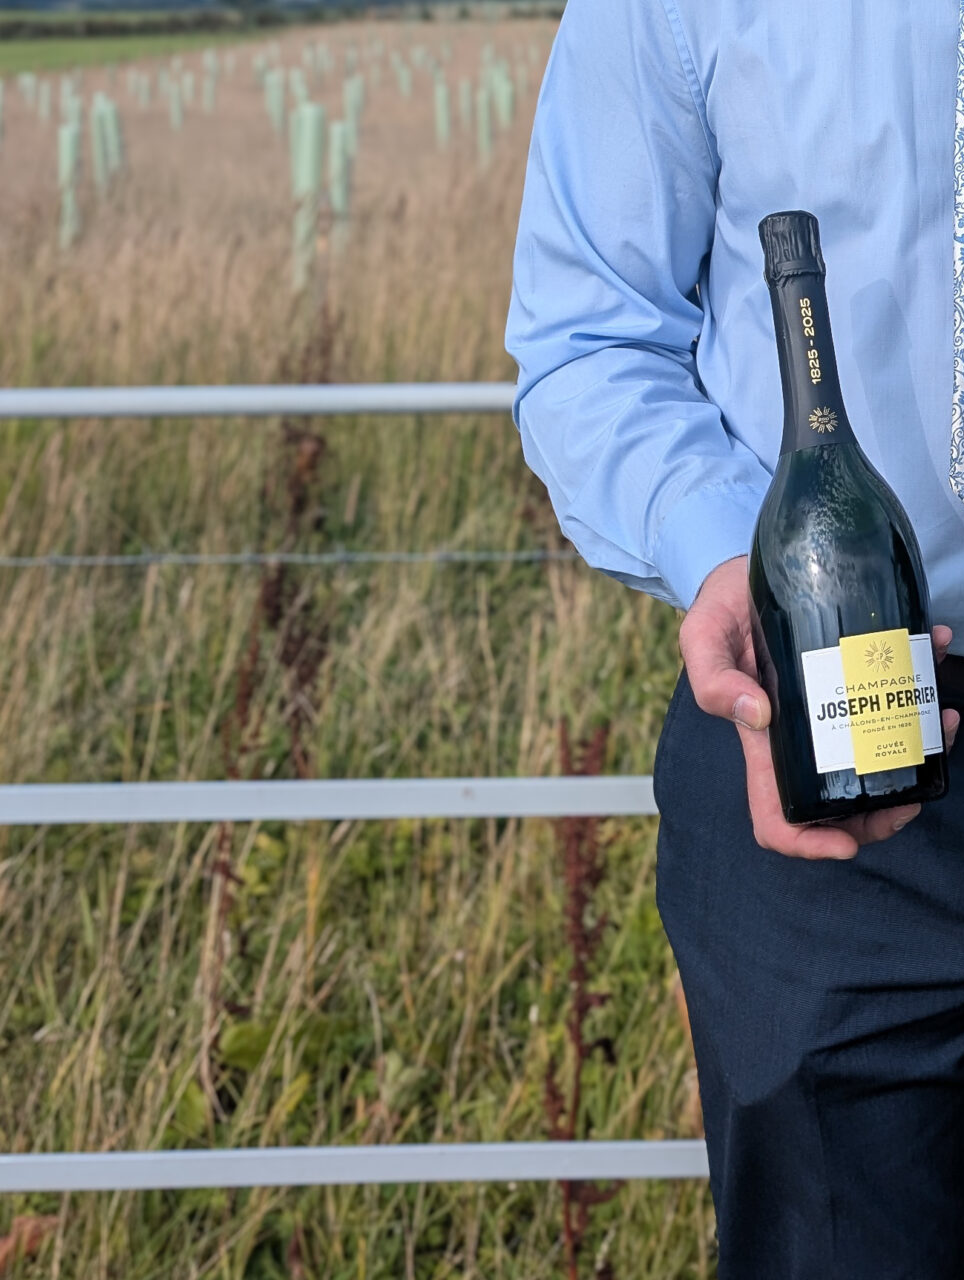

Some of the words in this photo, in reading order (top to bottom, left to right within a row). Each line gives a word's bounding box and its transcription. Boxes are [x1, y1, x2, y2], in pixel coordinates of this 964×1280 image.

[800, 297, 815, 337] 2025
[808, 349, 822, 385] 1825
[835, 673, 923, 695] CHAMPAGNE
[817, 694, 881, 722] JOSEPH
[886, 686, 937, 710] PERRIER
[838, 709, 932, 730] CHÂLONS-EN-CHAMPAGNE
[862, 724, 886, 734] FONDÉ
[875, 748, 908, 758] ROYALE
[876, 740, 905, 751] CUVÉE
